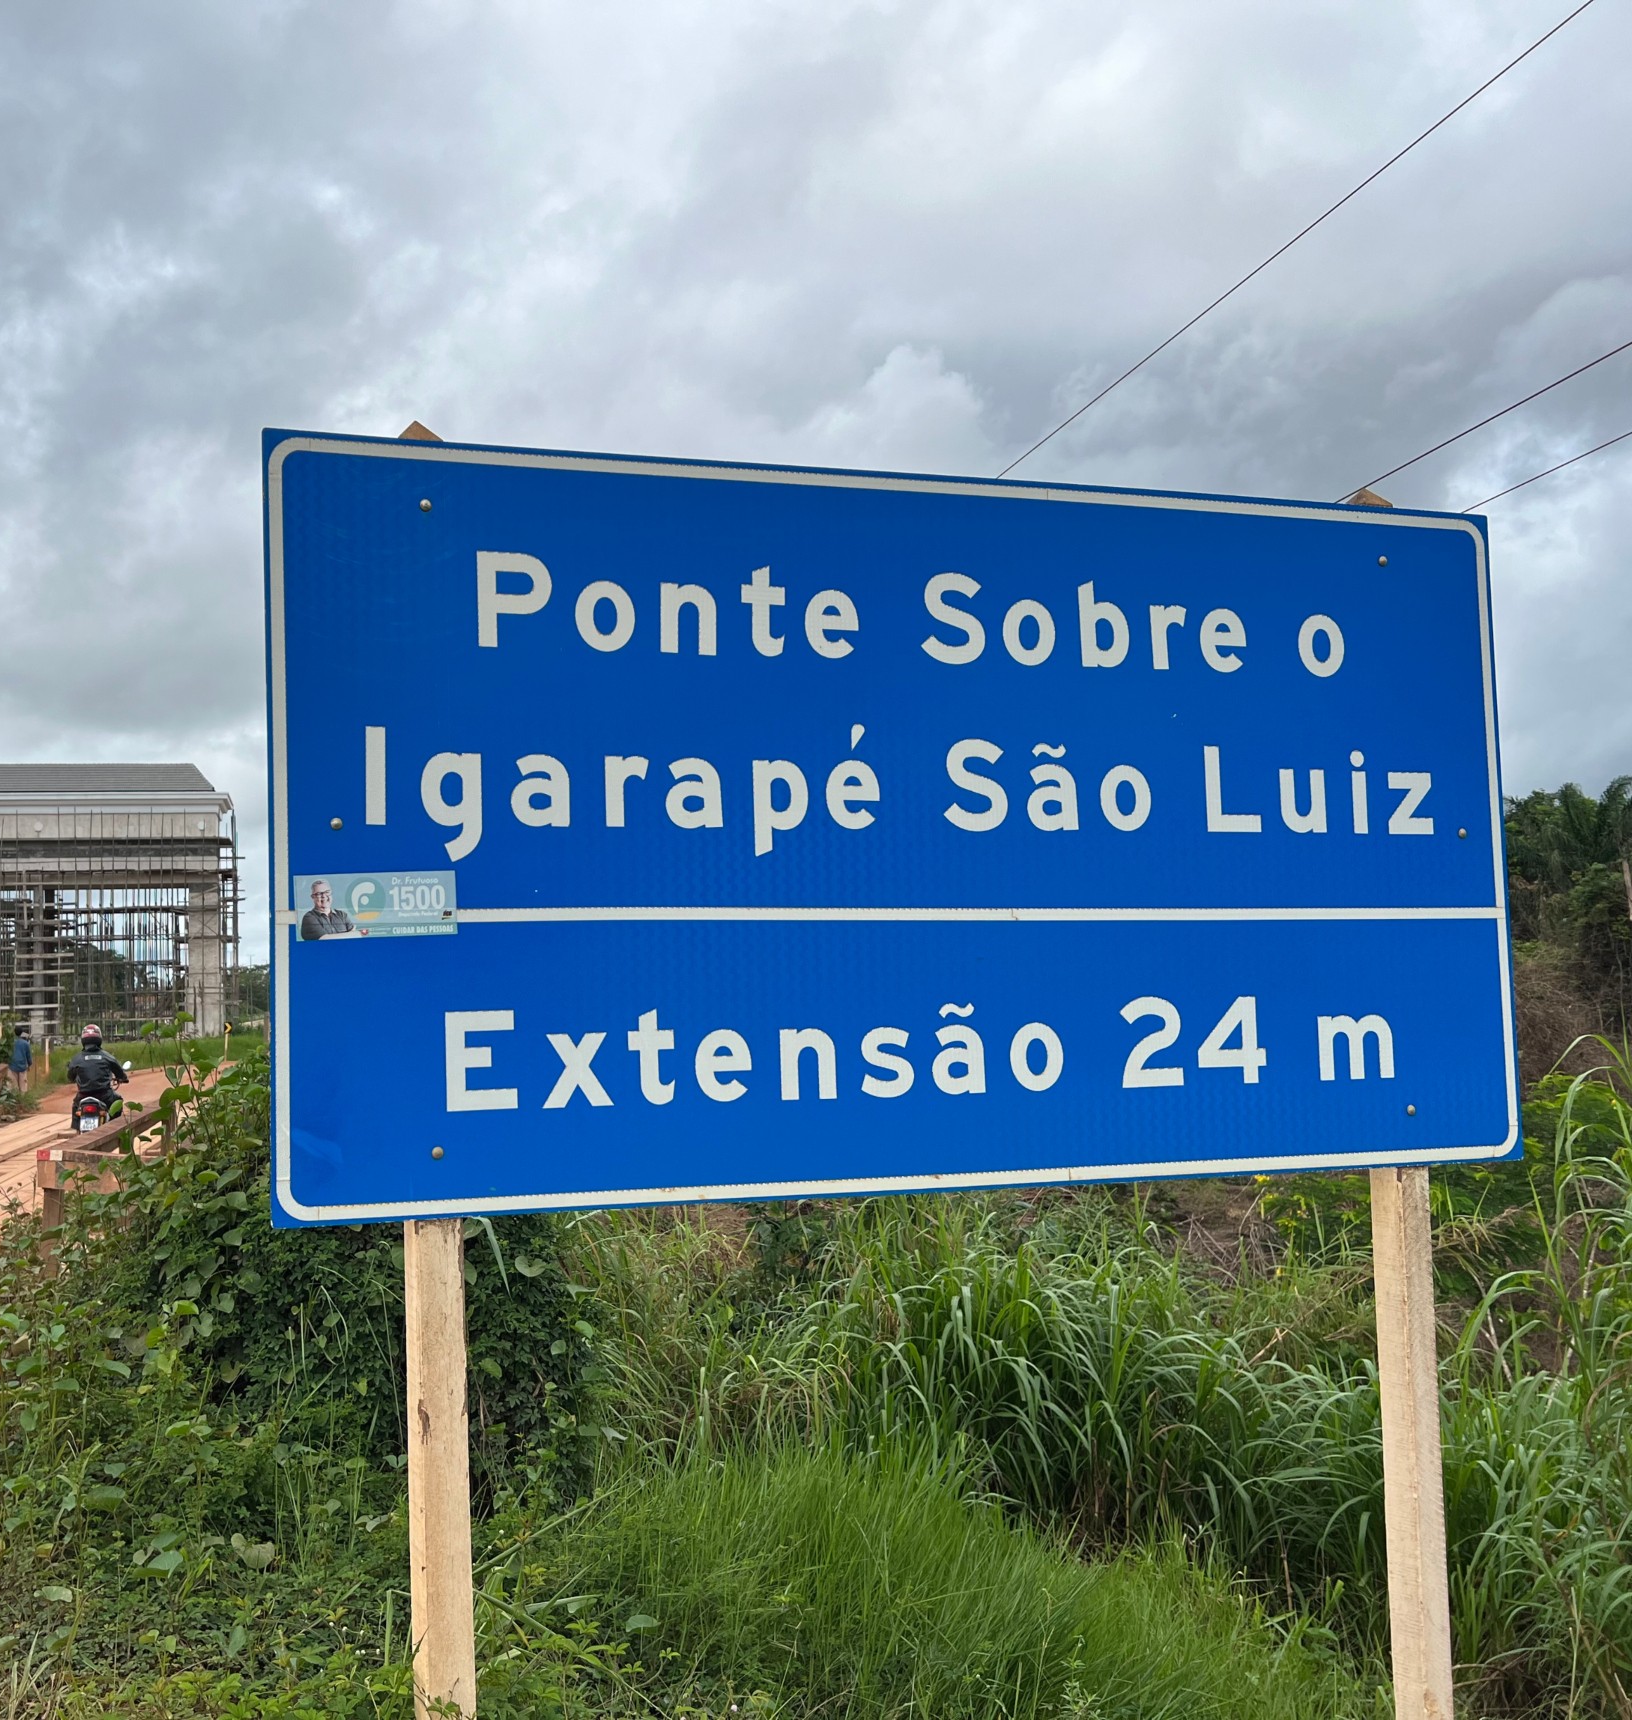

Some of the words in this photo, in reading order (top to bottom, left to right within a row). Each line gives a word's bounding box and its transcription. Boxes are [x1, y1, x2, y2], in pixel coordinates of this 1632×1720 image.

[476, 550, 859, 660] Ponte
[921, 572, 1247, 674] Sobre
[1297, 614, 1345, 678] o
[365, 724, 881, 862] Igarapé
[943, 738, 1152, 832] São
[1203, 745, 1434, 835] Luiz
[389, 885, 446, 911] 1500
[391, 876, 403, 885] Dr.
[405, 876, 439, 885] Frutuoso
[392, 926, 415, 935] CUIDAR
[416, 926, 428, 934] DAS
[429, 925, 454, 933] PESSOAS
[444, 1002, 1064, 1112] Extensão
[1119, 995, 1268, 1089] 24
[1317, 1014, 1395, 1081] m
